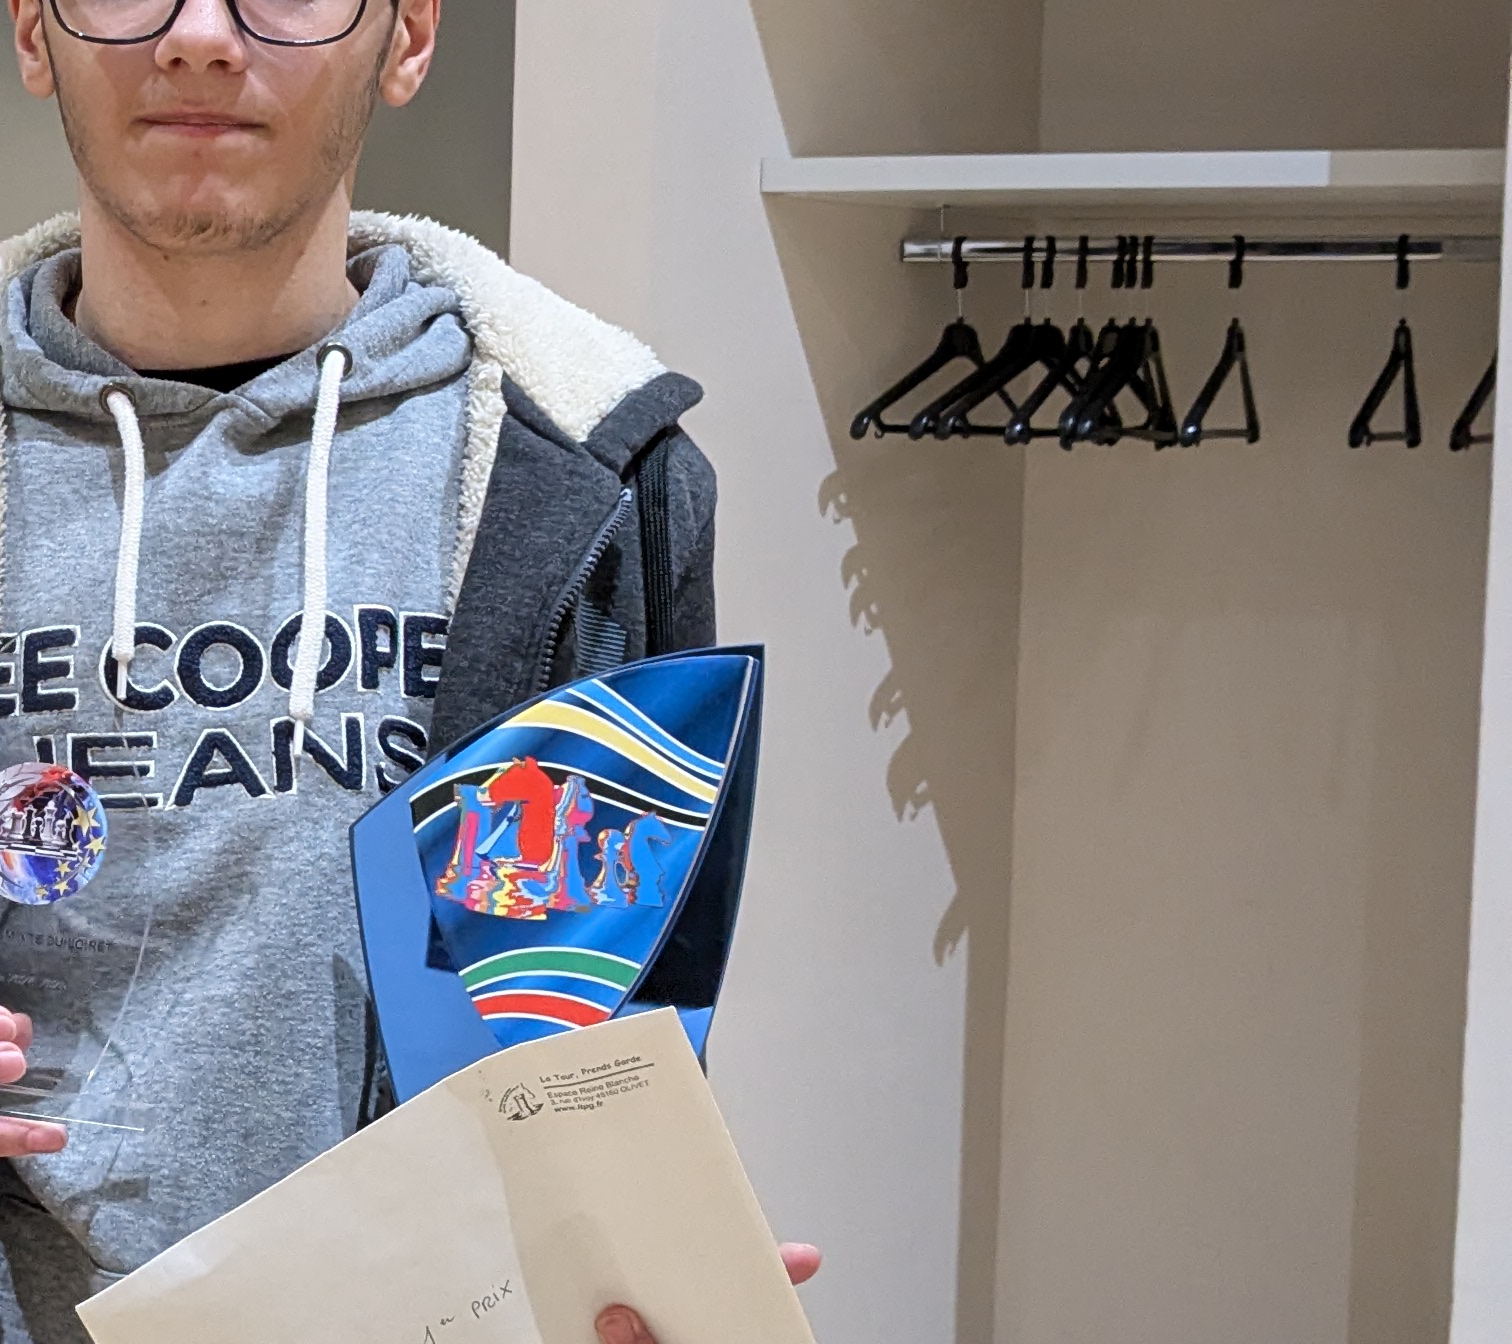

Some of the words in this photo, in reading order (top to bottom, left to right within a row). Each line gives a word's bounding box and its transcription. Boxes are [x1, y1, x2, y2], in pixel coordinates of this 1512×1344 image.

[98, 603, 449, 712] COOPE
[539, 1076, 551, 1084] La
[581, 1063, 612, 1075] Prends
[614, 1056, 642, 1067] Garde
[547, 1089, 578, 1099] Espace
[579, 1084, 604, 1095] Reine
[605, 1075, 640, 1089] Blanche
[620, 1079, 649, 1093] OLIVET
